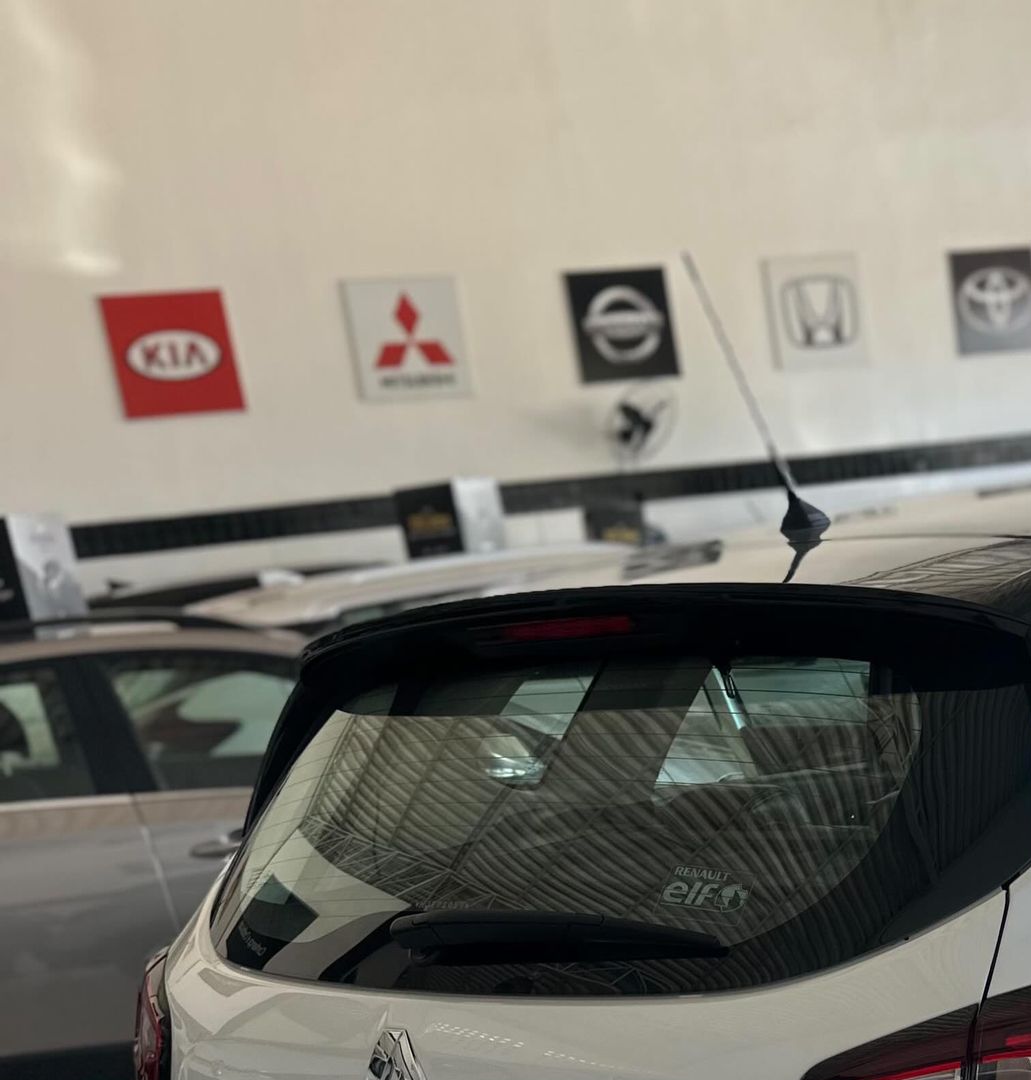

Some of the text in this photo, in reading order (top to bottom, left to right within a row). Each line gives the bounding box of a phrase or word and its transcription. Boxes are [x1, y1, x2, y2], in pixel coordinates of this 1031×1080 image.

[141, 341, 208, 368] KIA
[674, 866, 731, 881] RENAULT
[662, 882, 721, 906] elf
